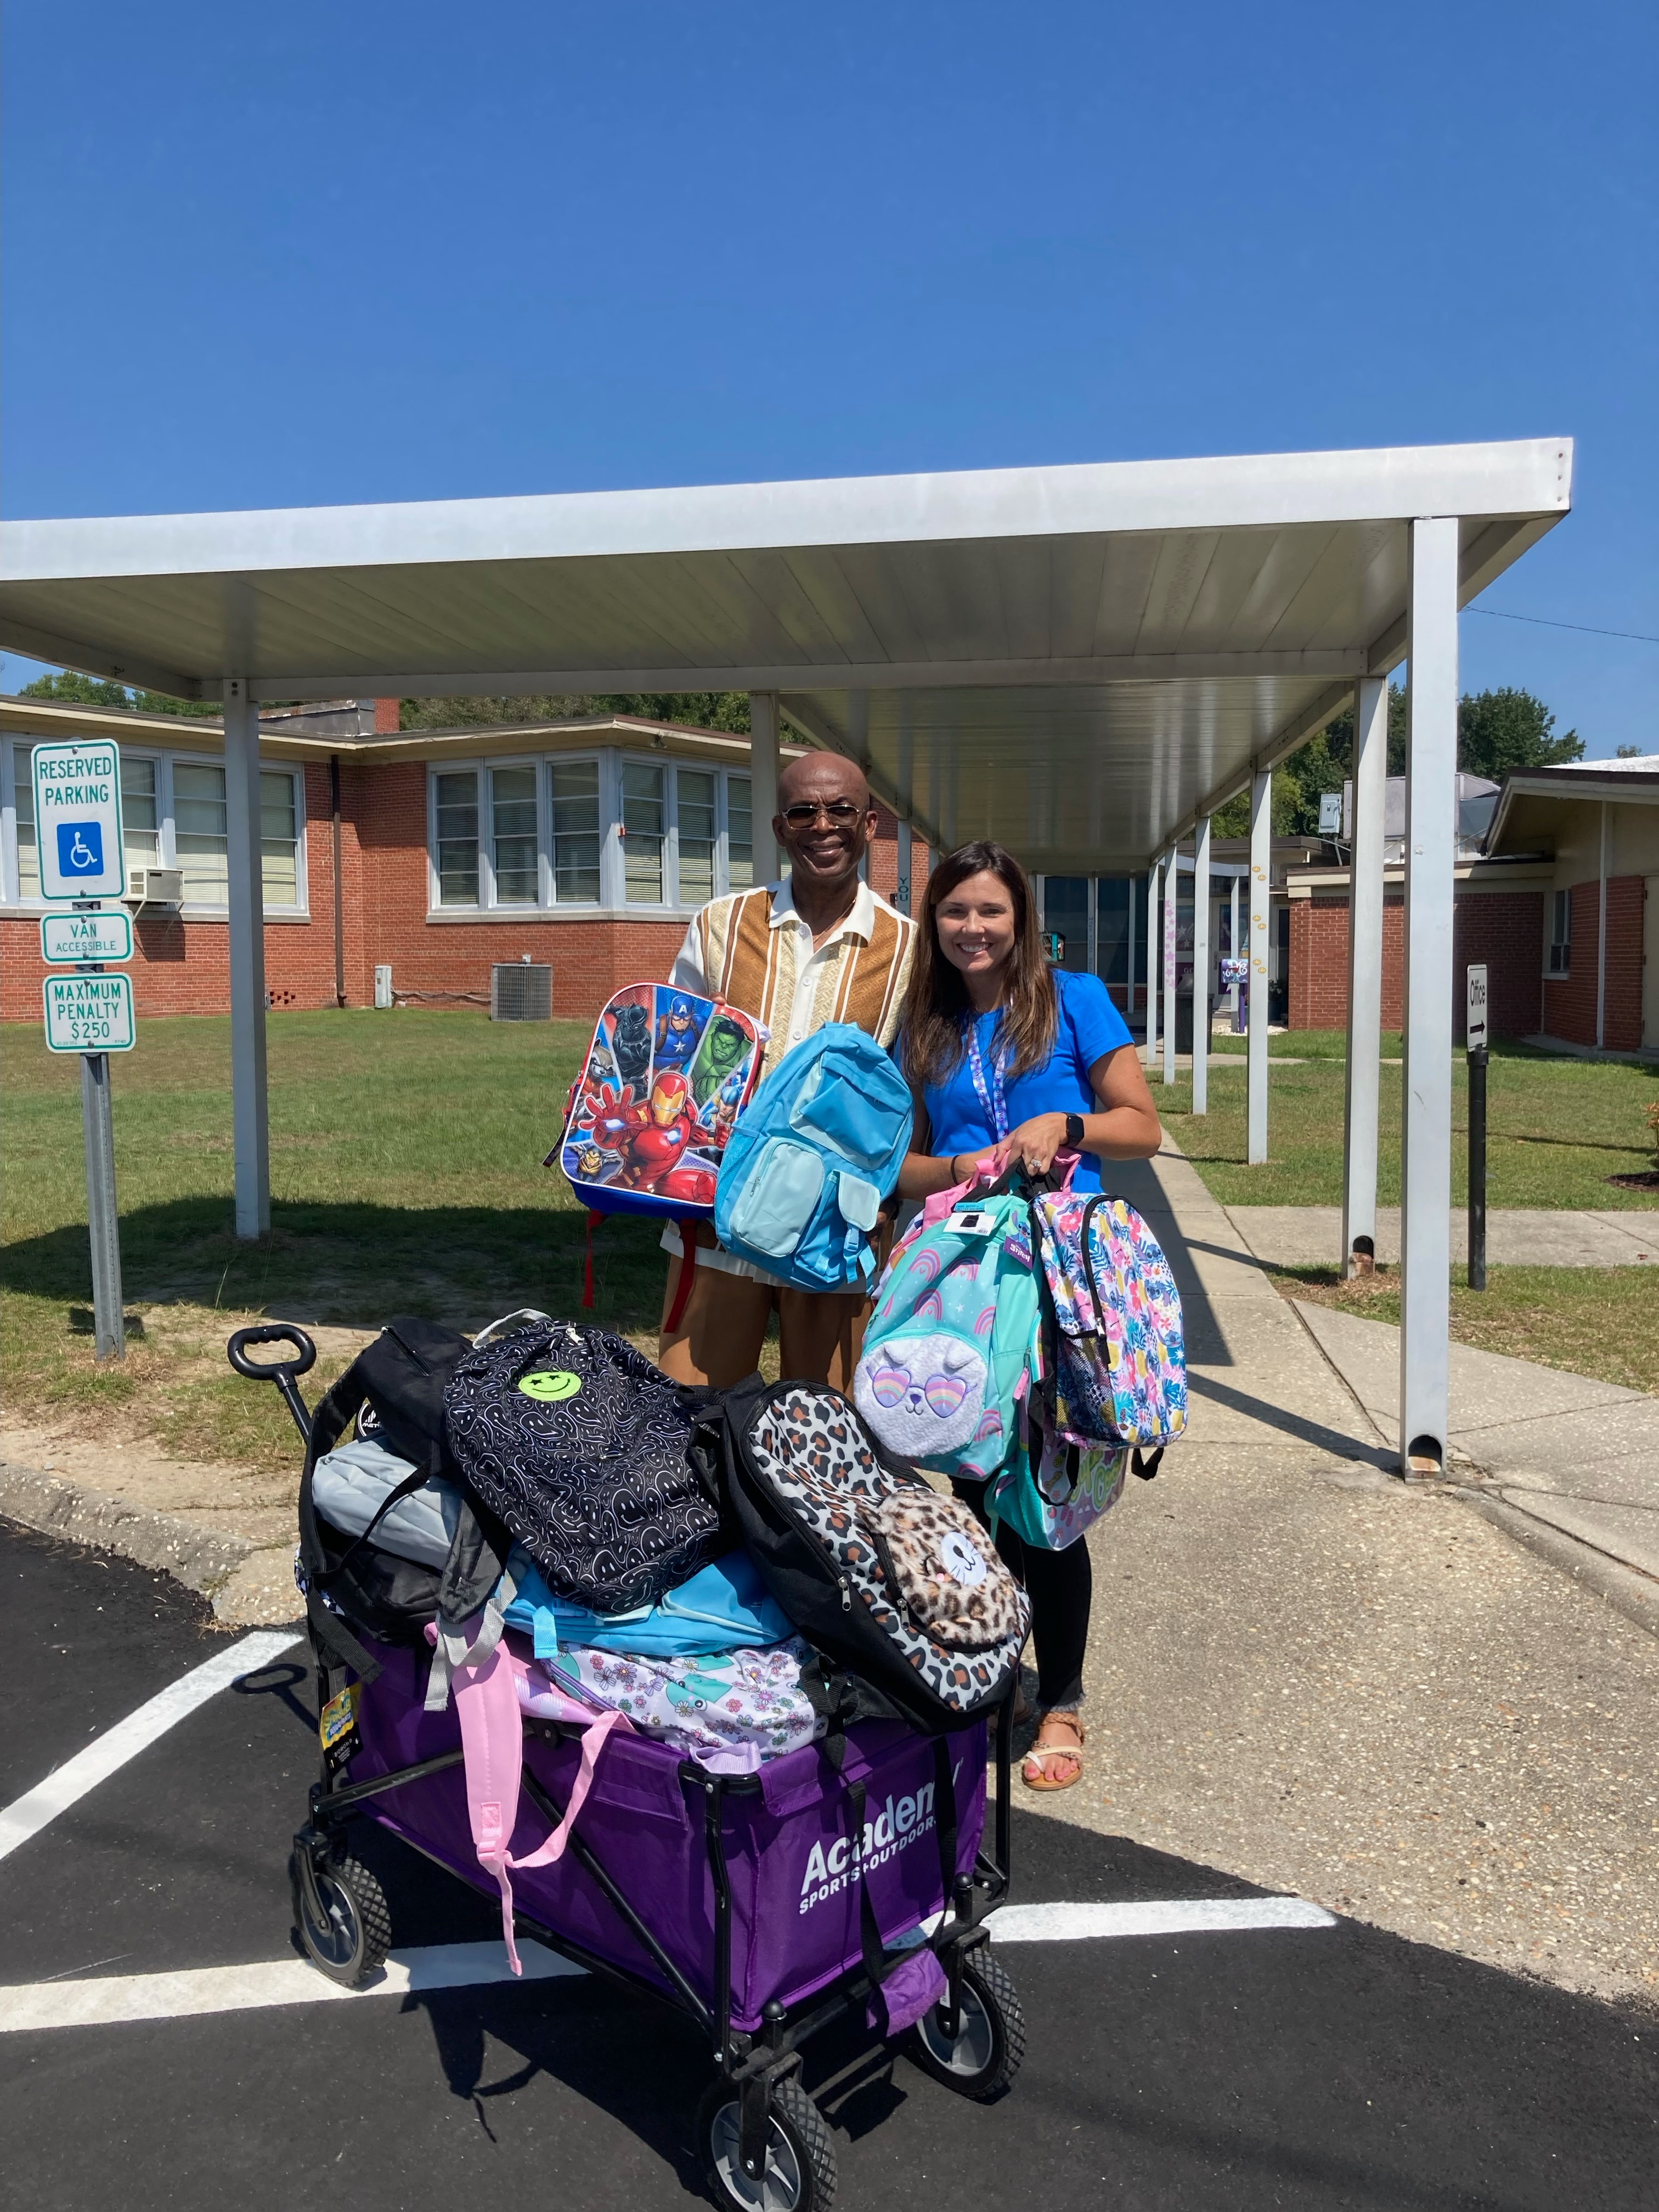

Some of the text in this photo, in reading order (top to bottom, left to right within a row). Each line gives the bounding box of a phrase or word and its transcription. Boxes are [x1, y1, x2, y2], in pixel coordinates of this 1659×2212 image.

[40, 757, 111, 780] RESERVED
[45, 784, 109, 806] PARKING
[899, 877, 909, 901] YOU
[70, 923, 97, 938] VAN
[56, 941, 116, 952] ACCESSIBLE
[54, 983, 121, 1001] MAXIMUM
[1470, 979, 1485, 1006] Office
[58, 1002, 119, 1020] PENALTY
[679, 1005, 687, 1014] A
[72, 1021, 109, 1040] $250
[801, 1757, 963, 1895] Academ
